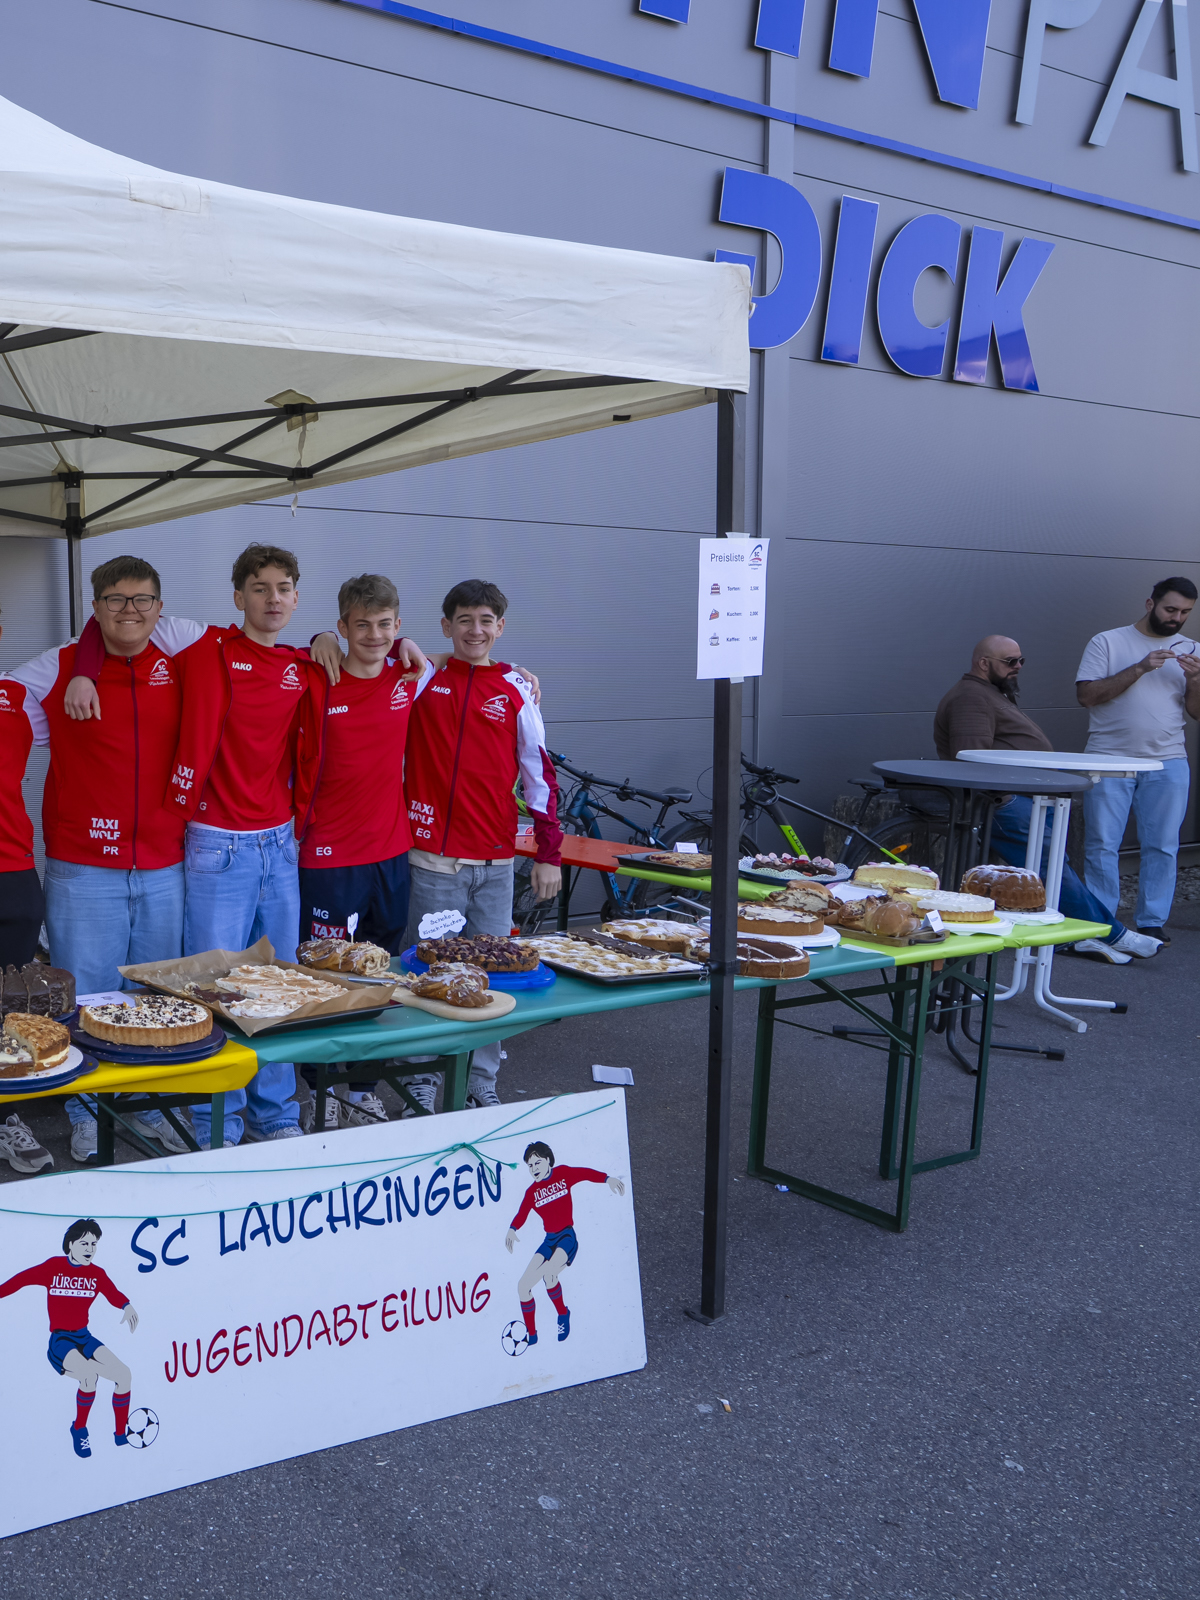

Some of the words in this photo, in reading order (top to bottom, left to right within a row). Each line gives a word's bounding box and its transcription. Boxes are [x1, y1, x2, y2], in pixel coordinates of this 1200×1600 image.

[714, 166, 1056, 393] DICK
[710, 553, 745, 563] Preisliste
[431, 685, 451, 695] JAKO
[328, 705, 348, 716] JAKO
[175, 794, 187, 805] JG
[200, 802, 207, 811] G
[411, 800, 434, 815] TAXI
[408, 810, 435, 825] WOLF
[91, 818, 119, 830] TAXI
[89, 828, 121, 840] WOLF
[416, 828, 432, 839] EG
[103, 846, 119, 856] PR
[316, 846, 332, 856] EG
[312, 906, 330, 920] MG
[314, 922, 345, 938] TAXI
[534, 1179, 567, 1202] JÜRGENS
[130, 1216, 189, 1273] SC
[50, 1273, 98, 1290] JÜRGENS
